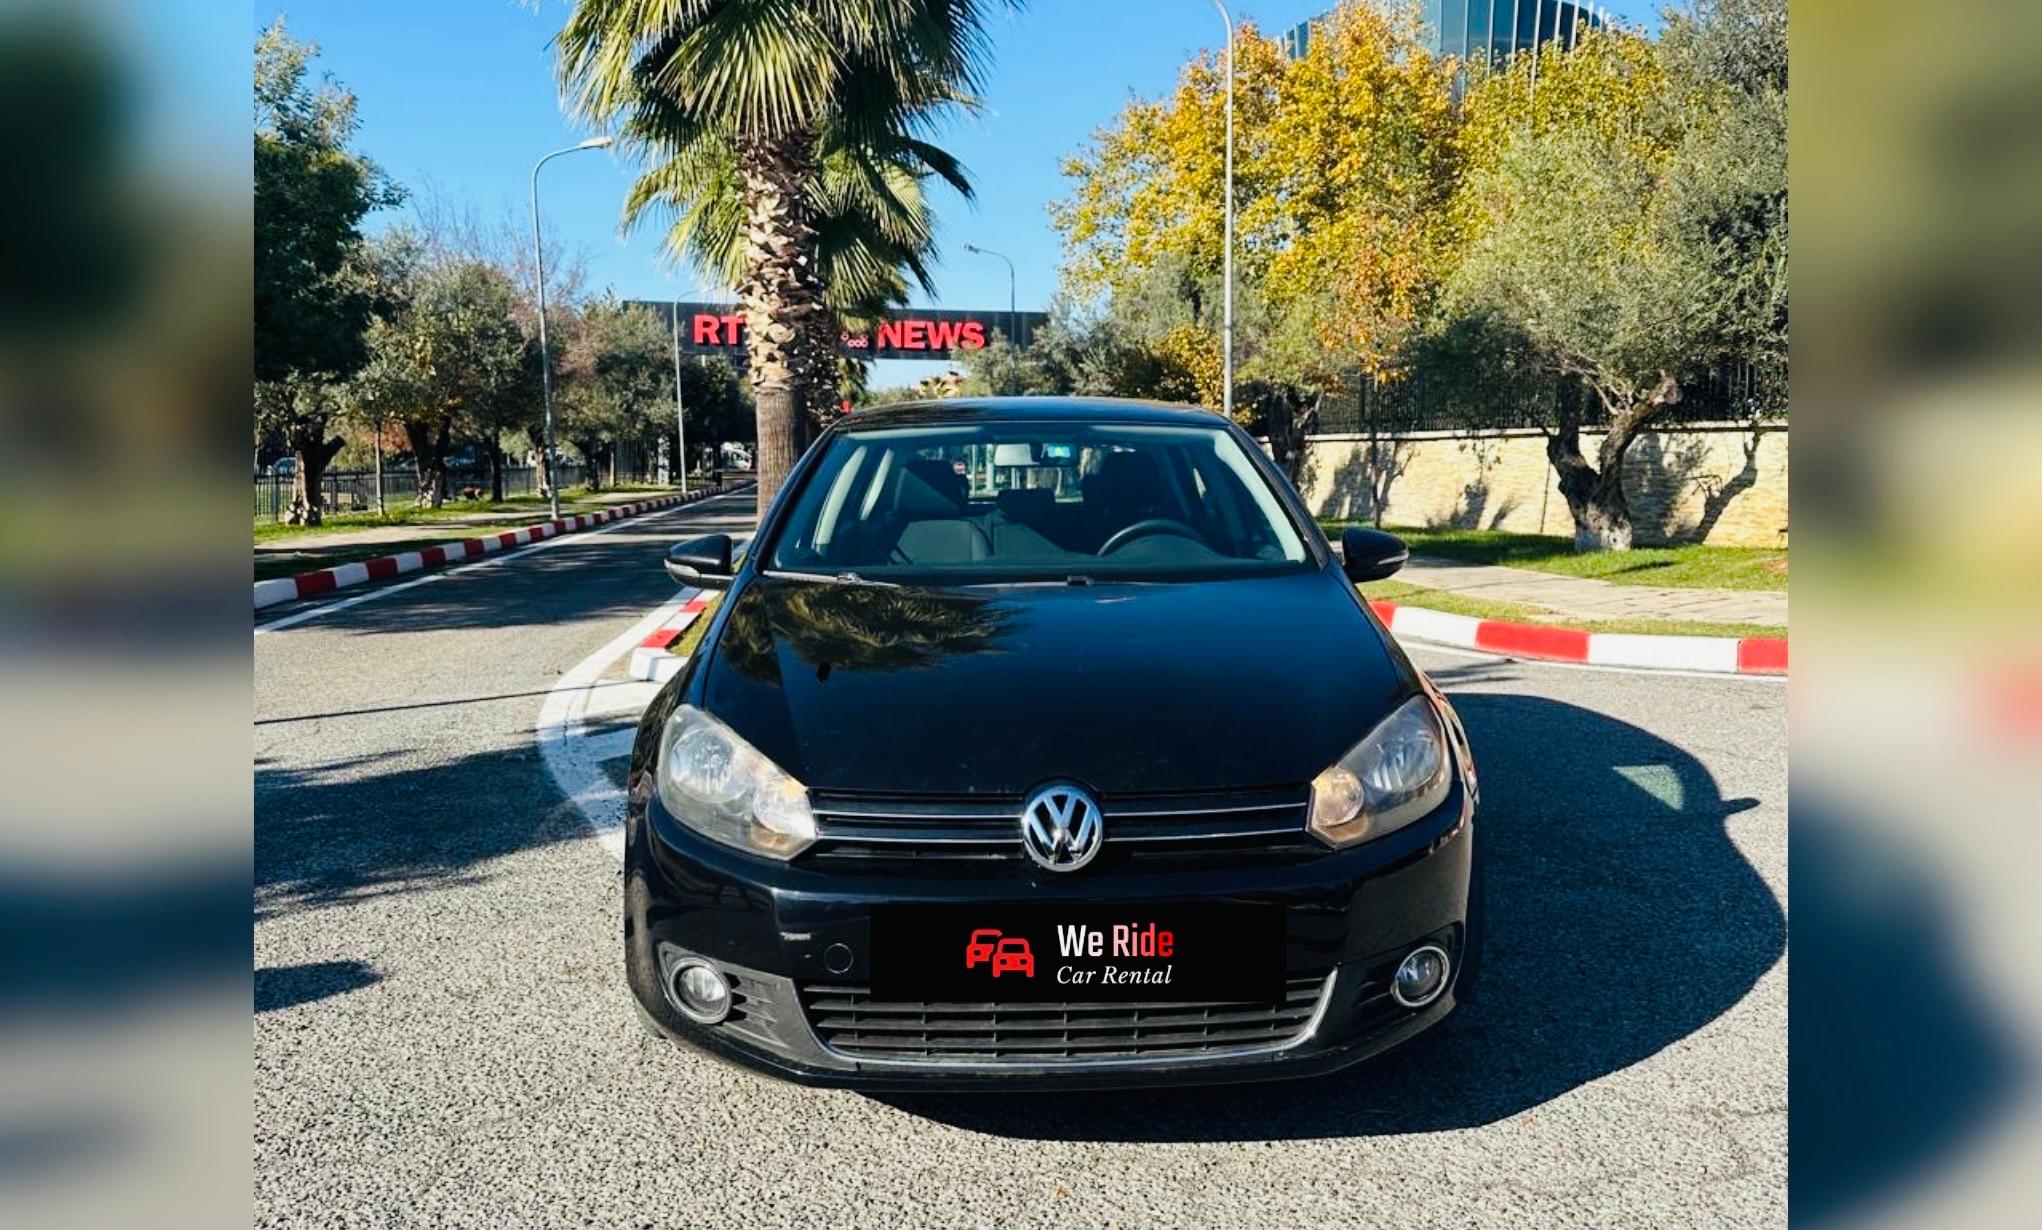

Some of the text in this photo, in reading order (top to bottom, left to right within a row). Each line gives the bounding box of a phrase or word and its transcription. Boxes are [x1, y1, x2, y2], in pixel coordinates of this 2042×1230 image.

[693, 313, 746, 345] RT
[877, 319, 986, 350] NEWS
[1022, 786, 1103, 872] VW
